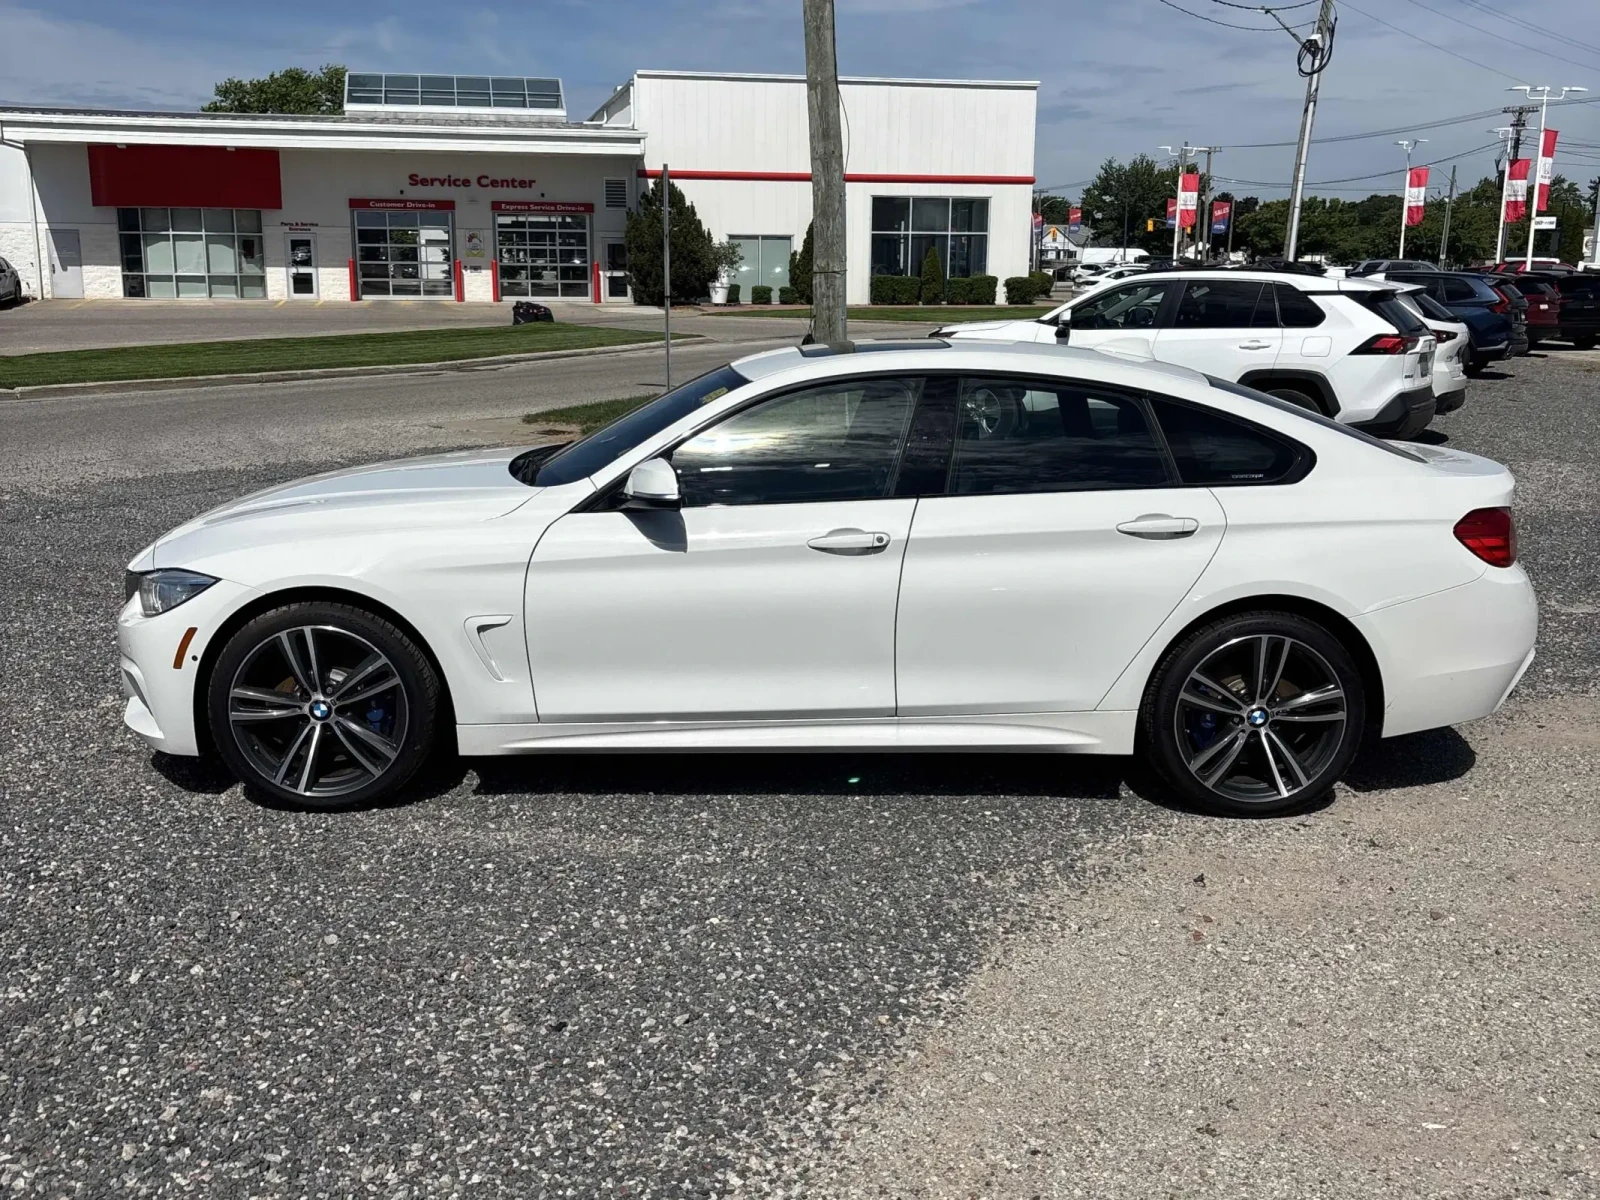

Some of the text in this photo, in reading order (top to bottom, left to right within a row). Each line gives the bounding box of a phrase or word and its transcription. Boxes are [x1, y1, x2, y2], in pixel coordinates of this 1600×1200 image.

[408, 173, 537, 189] Service Center
[369, 200, 436, 209] Customer Drive-in
[501, 203, 528, 211] Express
[529, 203, 555, 211] Service
